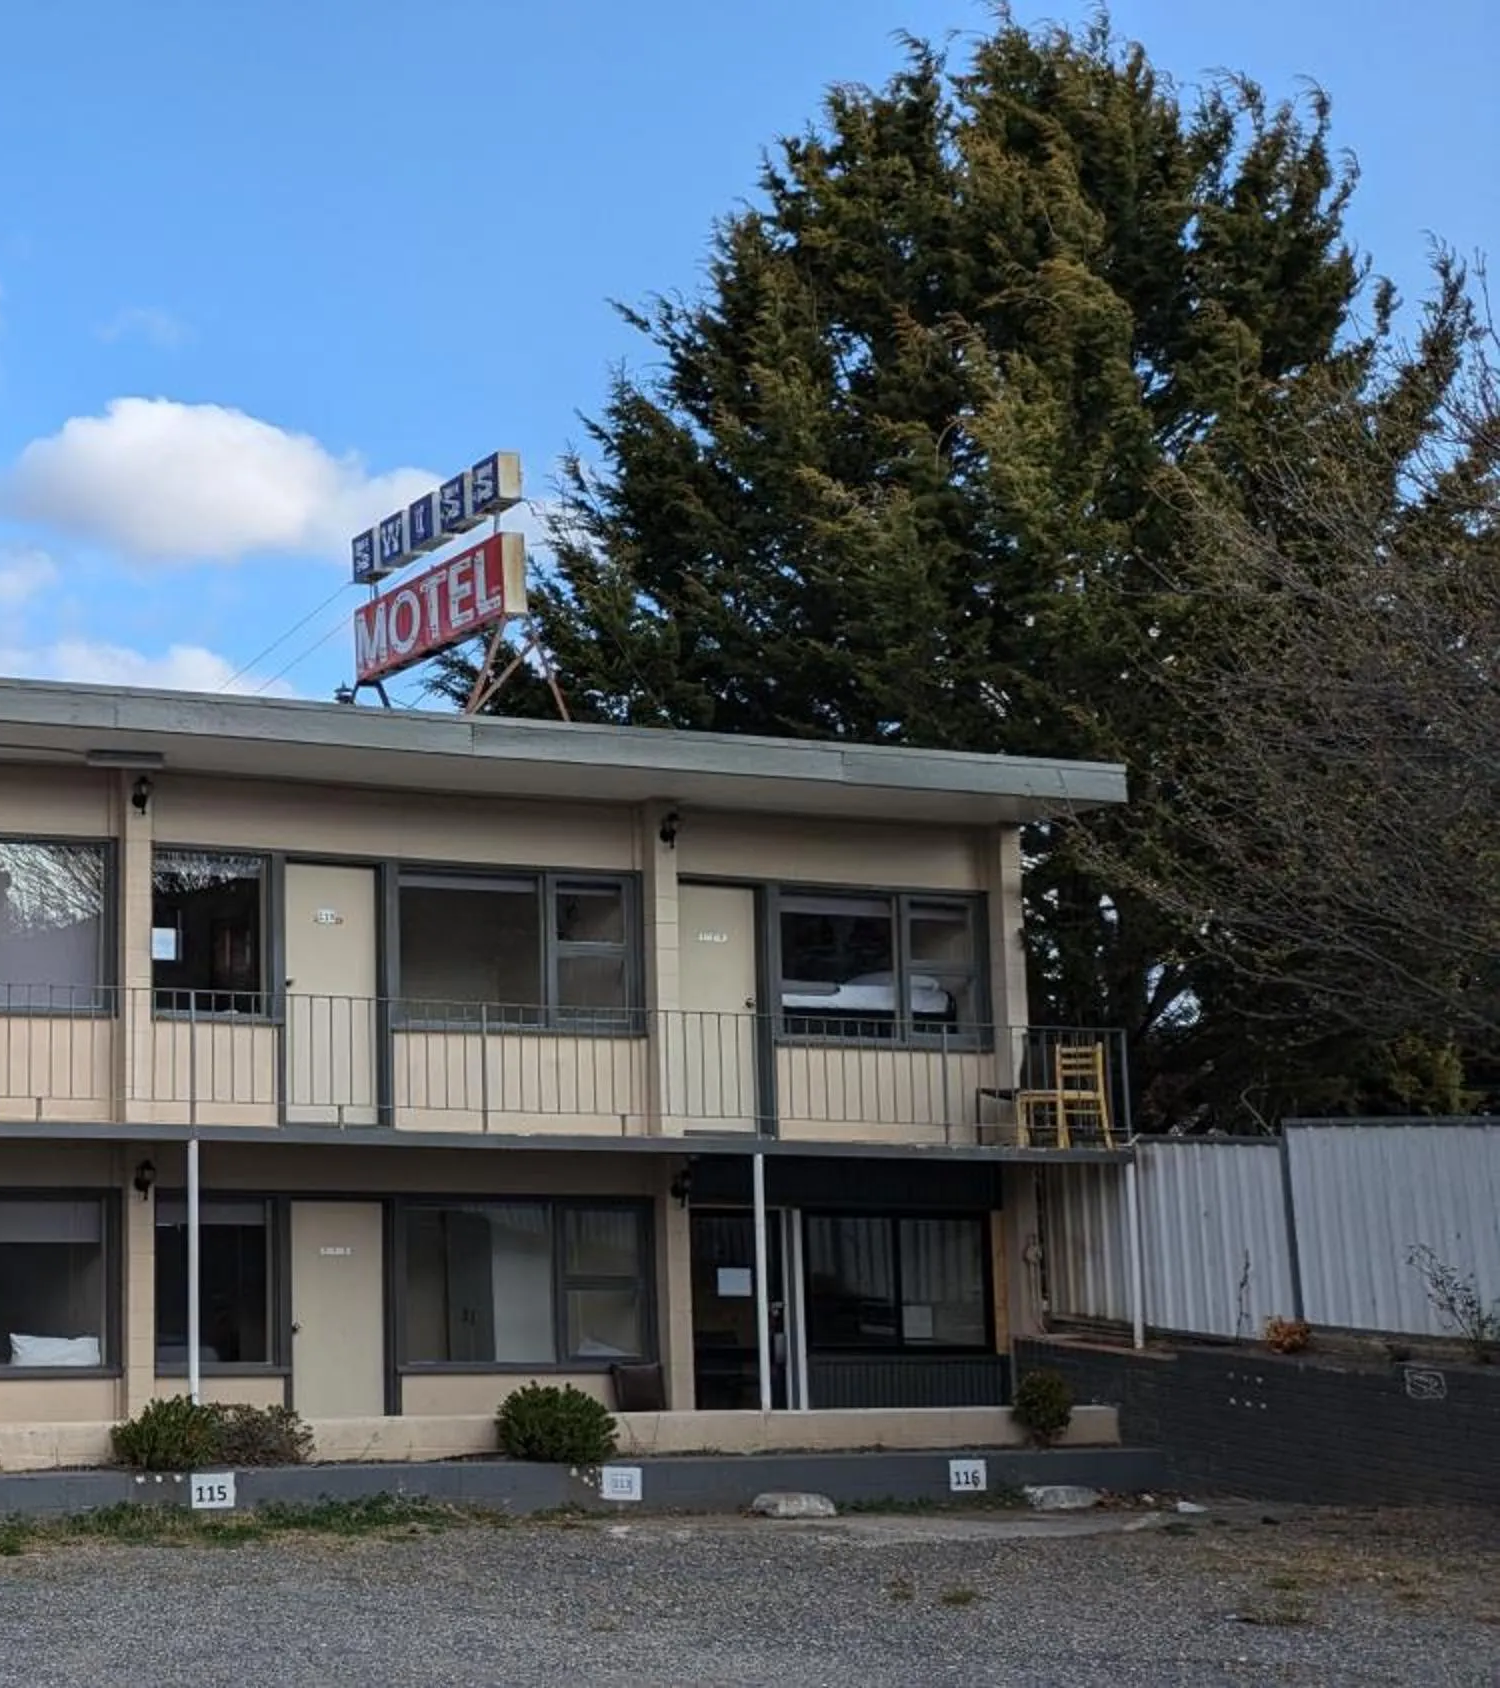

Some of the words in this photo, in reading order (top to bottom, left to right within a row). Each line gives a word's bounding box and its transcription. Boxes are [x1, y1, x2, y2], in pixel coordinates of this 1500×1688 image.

[356, 461, 494, 574] SWISS
[356, 548, 501, 679] MOTEL
[196, 1485, 227, 1503] 115
[954, 1470, 980, 1487] 116
